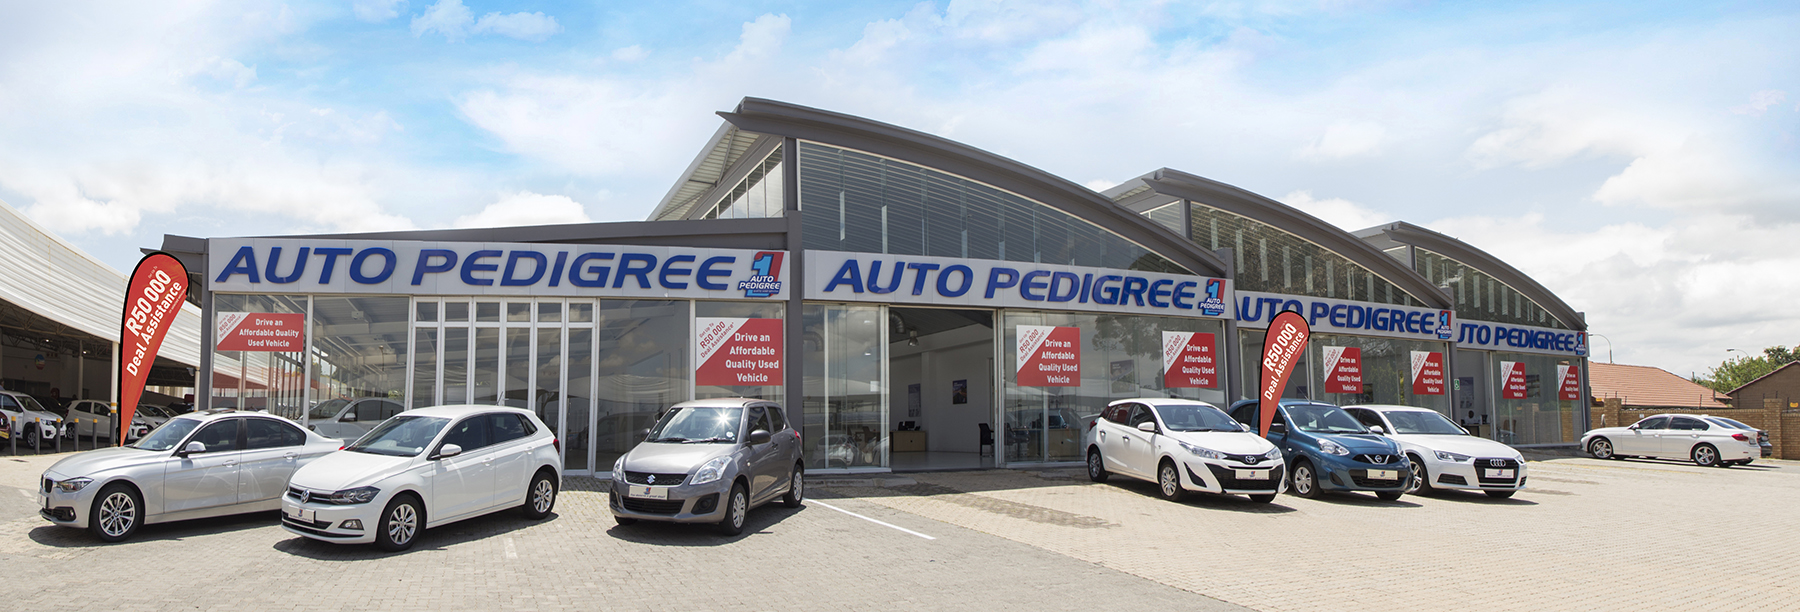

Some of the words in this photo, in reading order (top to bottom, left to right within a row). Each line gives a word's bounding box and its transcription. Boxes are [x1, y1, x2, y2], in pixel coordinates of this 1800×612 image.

[214, 246, 397, 285] AUTO
[410, 249, 736, 291] PEDIGREE
[739, 282, 781, 290] PEDIGREE
[823, 259, 974, 298] AUTO
[984, 267, 1197, 310] PEDIGREE
[125, 297, 152, 337] R50
[144, 270, 171, 302] 000
[1310, 302, 1434, 335] PEDIGREE
[126, 342, 147, 377] Deal
[140, 282, 181, 345] Assistance
[275, 329, 299, 338] Quality
[700, 333, 714, 349] R50
[712, 321, 726, 336] 000
[735, 333, 757, 342] Drive
[1456, 323, 1491, 345] UTO
[1494, 326, 1574, 352] PEDIGREE
[1020, 340, 1030, 353] R50
[1029, 329, 1039, 341] 000
[1045, 339, 1062, 347] Drive
[700, 346, 712, 358] Deal
[730, 346, 775, 355] Affordable
[1263, 343, 1280, 372] R50
[1277, 323, 1297, 349] 000
[1042, 351, 1075, 359] Affordable
[1184, 355, 1211, 363] Affordable
[726, 360, 756, 370] Quality
[758, 360, 779, 368] Used
[1039, 363, 1061, 373] Quality
[1264, 376, 1279, 400] Deal
[1274, 331, 1305, 377] Assistance
[1182, 366, 1201, 375] Quality
[737, 373, 768, 382] Vehicle
[1047, 375, 1070, 383] Vehicle
[1189, 377, 1208, 385] Vehicle
